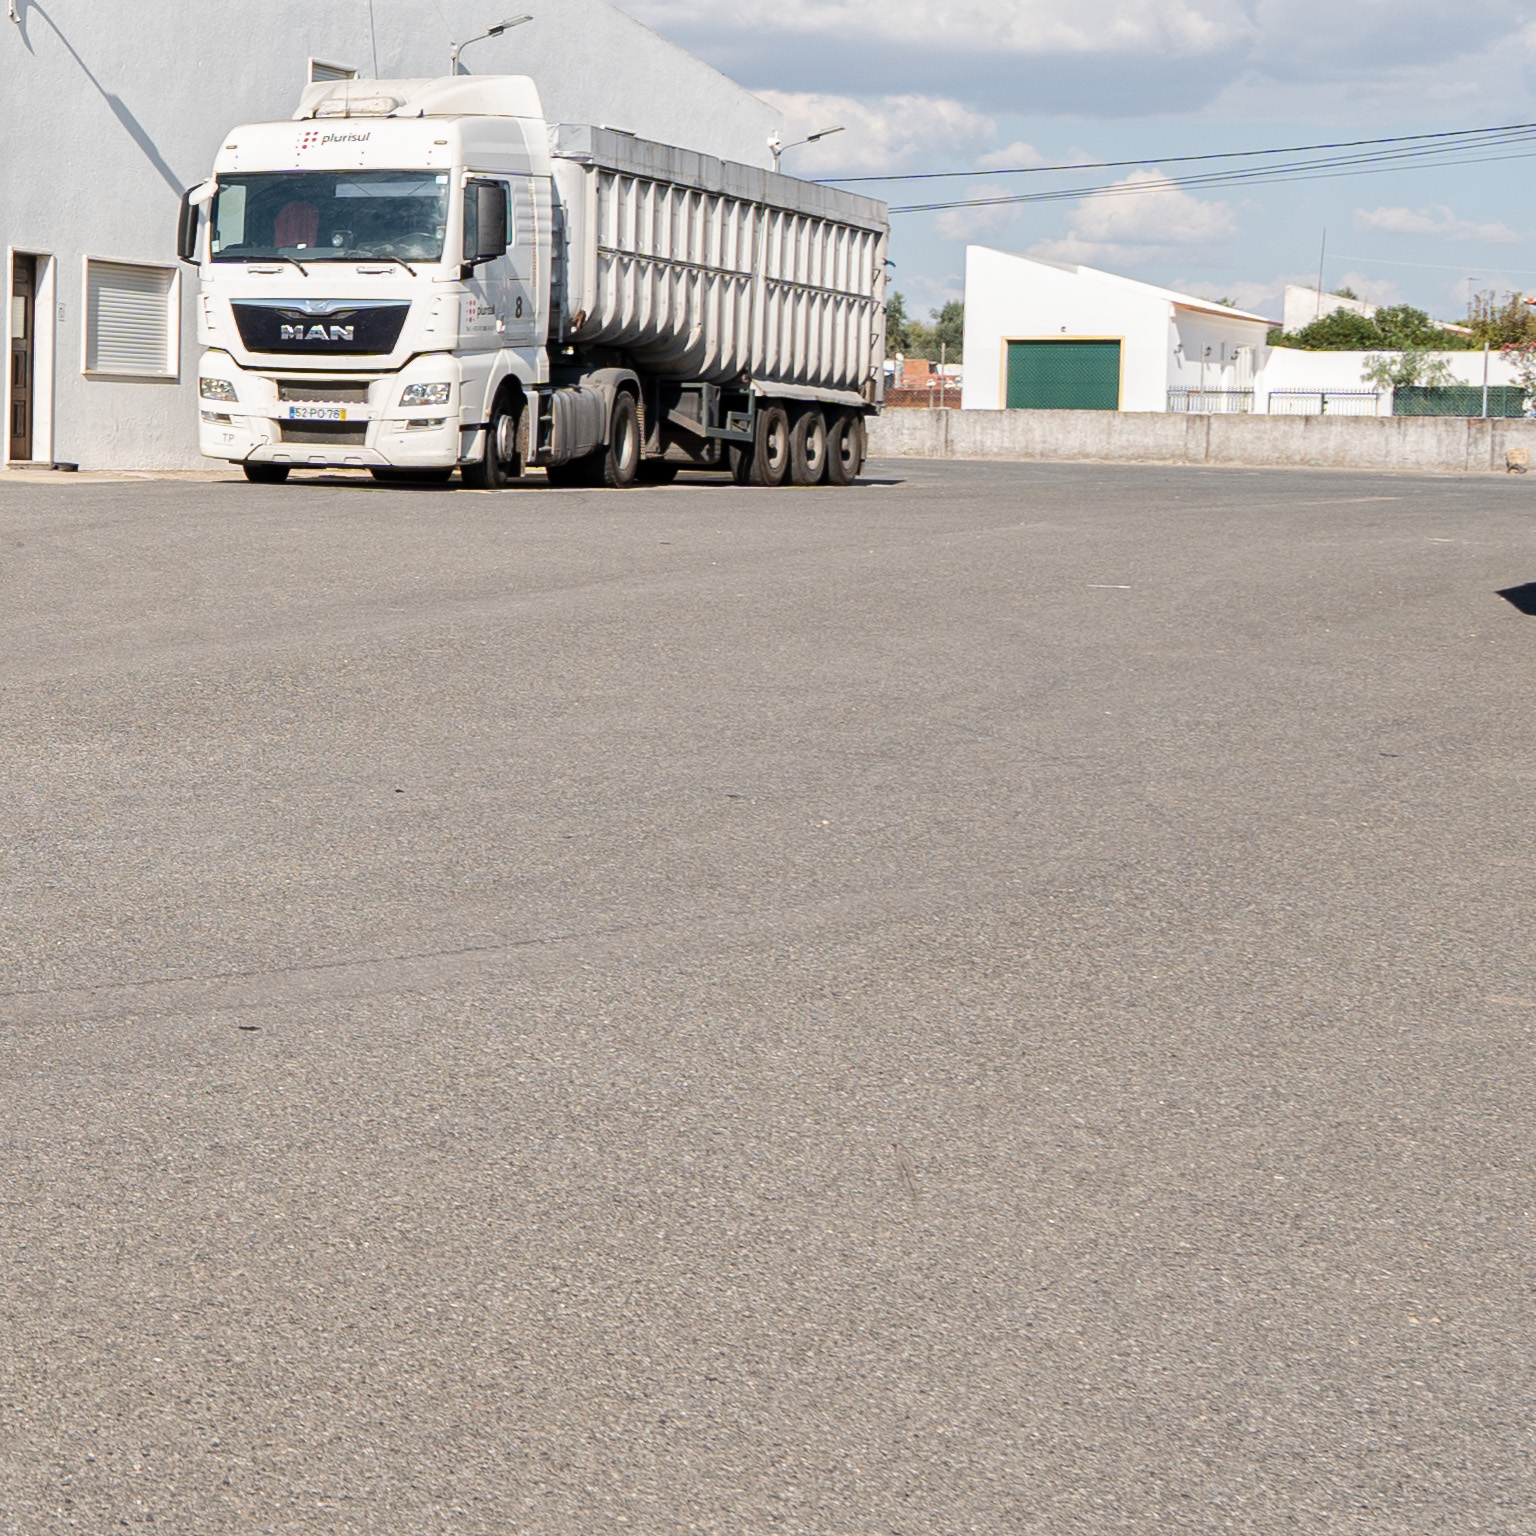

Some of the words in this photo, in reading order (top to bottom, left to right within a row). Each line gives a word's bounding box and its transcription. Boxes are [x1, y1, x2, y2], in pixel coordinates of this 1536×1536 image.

[321, 132, 370, 145] plurisul
[515, 296, 523, 318] 8
[280, 324, 355, 341] MAN
